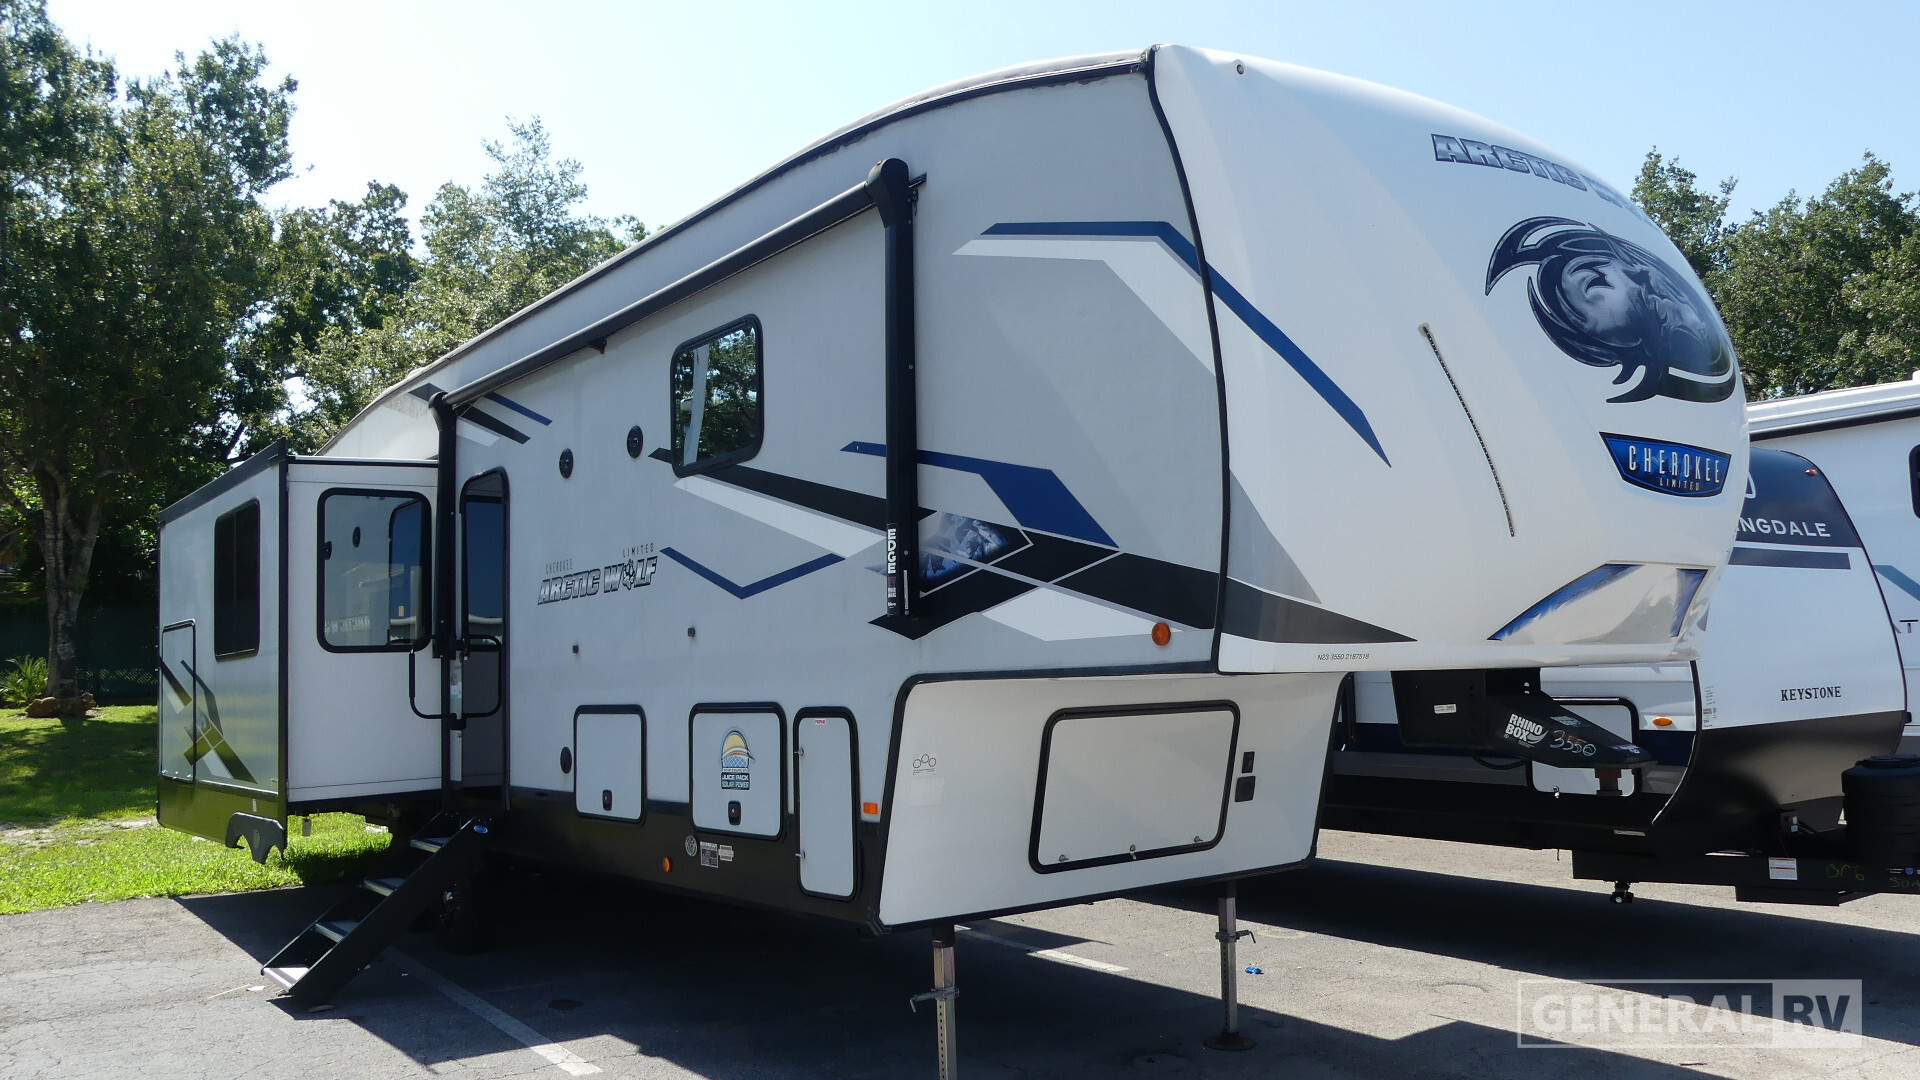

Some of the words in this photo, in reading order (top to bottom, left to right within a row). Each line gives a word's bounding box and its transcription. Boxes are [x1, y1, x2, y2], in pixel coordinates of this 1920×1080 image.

[1431, 133, 1588, 192] ARCTIC
[1628, 445, 1720, 483] CHEROKEE
[1659, 478, 1700, 491] LIMITED
[622, 542, 654, 558] LIMITED
[887, 528, 897, 574] EDGE
[545, 558, 573, 575] CHEROKEE
[537, 568, 601, 605] ARCTIC
[1317, 653, 1330, 661] N23
[1780, 686, 1842, 702] KEYSTONE
[1505, 723, 1531, 742] BOX
[1508, 713, 1543, 736] RHINO
[1549, 729, 1597, 757] 3550
